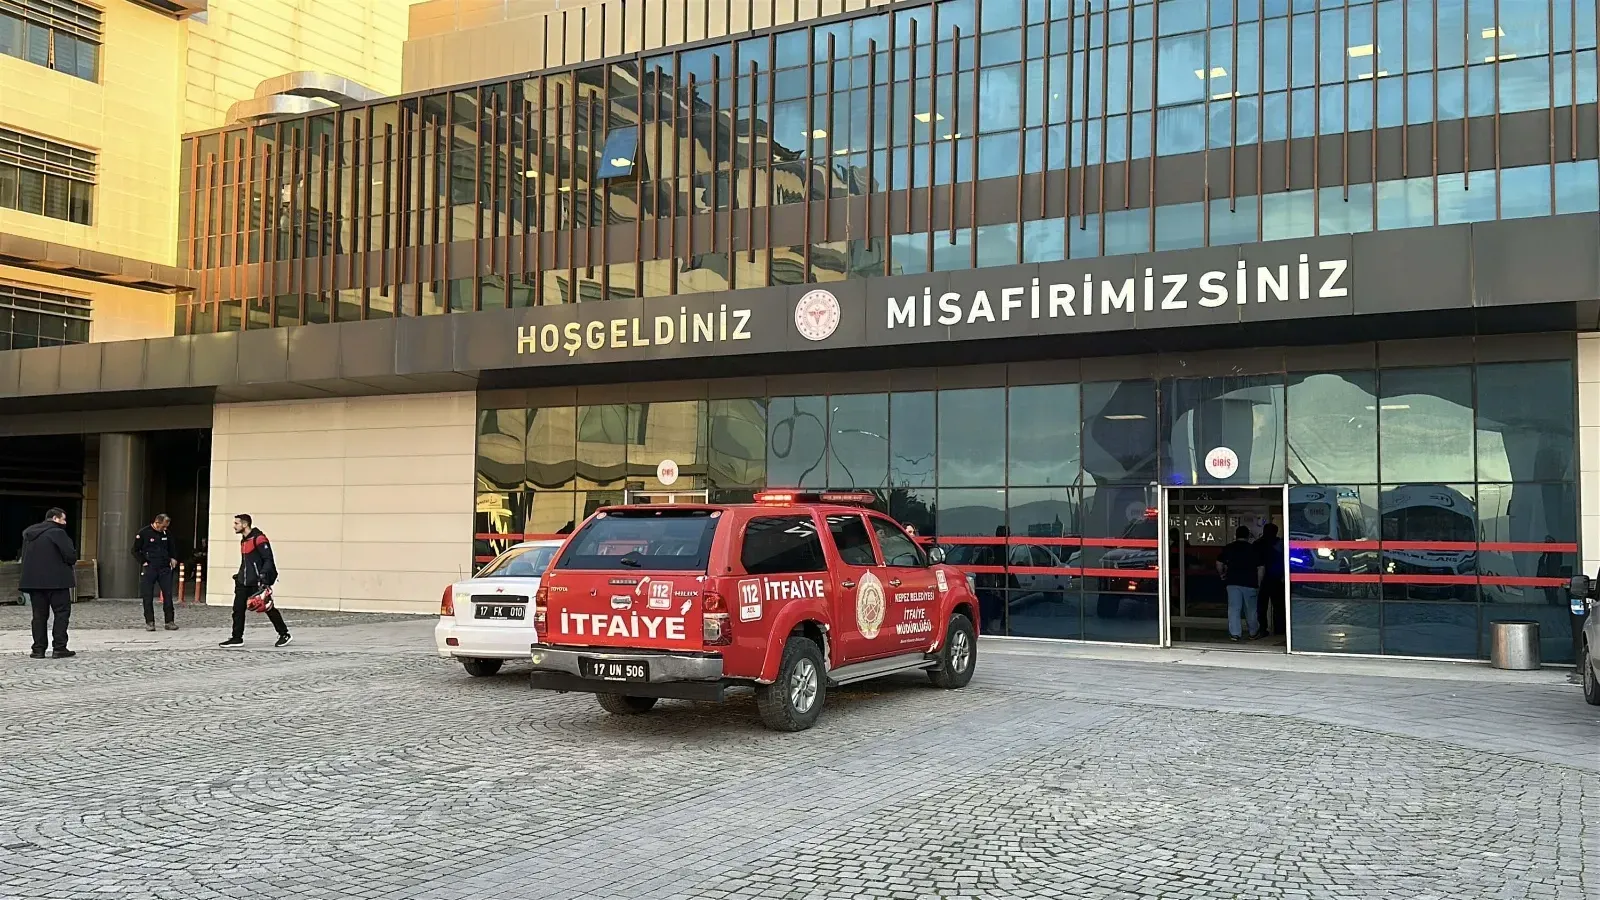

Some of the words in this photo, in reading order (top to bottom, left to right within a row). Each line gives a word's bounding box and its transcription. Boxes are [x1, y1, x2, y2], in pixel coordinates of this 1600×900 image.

[517, 304, 751, 356] HOŞGELDİNİZ
[887, 254, 1348, 329] MİSAFİRİMİZSİNİZ
[1212, 456, 1231, 469] GİRİŞ
[652, 584, 669, 598] 112
[742, 584, 759, 604] 112
[764, 575, 824, 601] İTFAİYE
[480, 606, 488, 616] 17
[903, 605, 926, 620] İTFAİYE
[560, 607, 686, 640] İTFAİYE
[895, 619, 932, 635] MÜDÜRLÜĞÜ
[594, 663, 605, 675] 17
[609, 664, 622, 676] UN
[626, 665, 644, 678] 506
